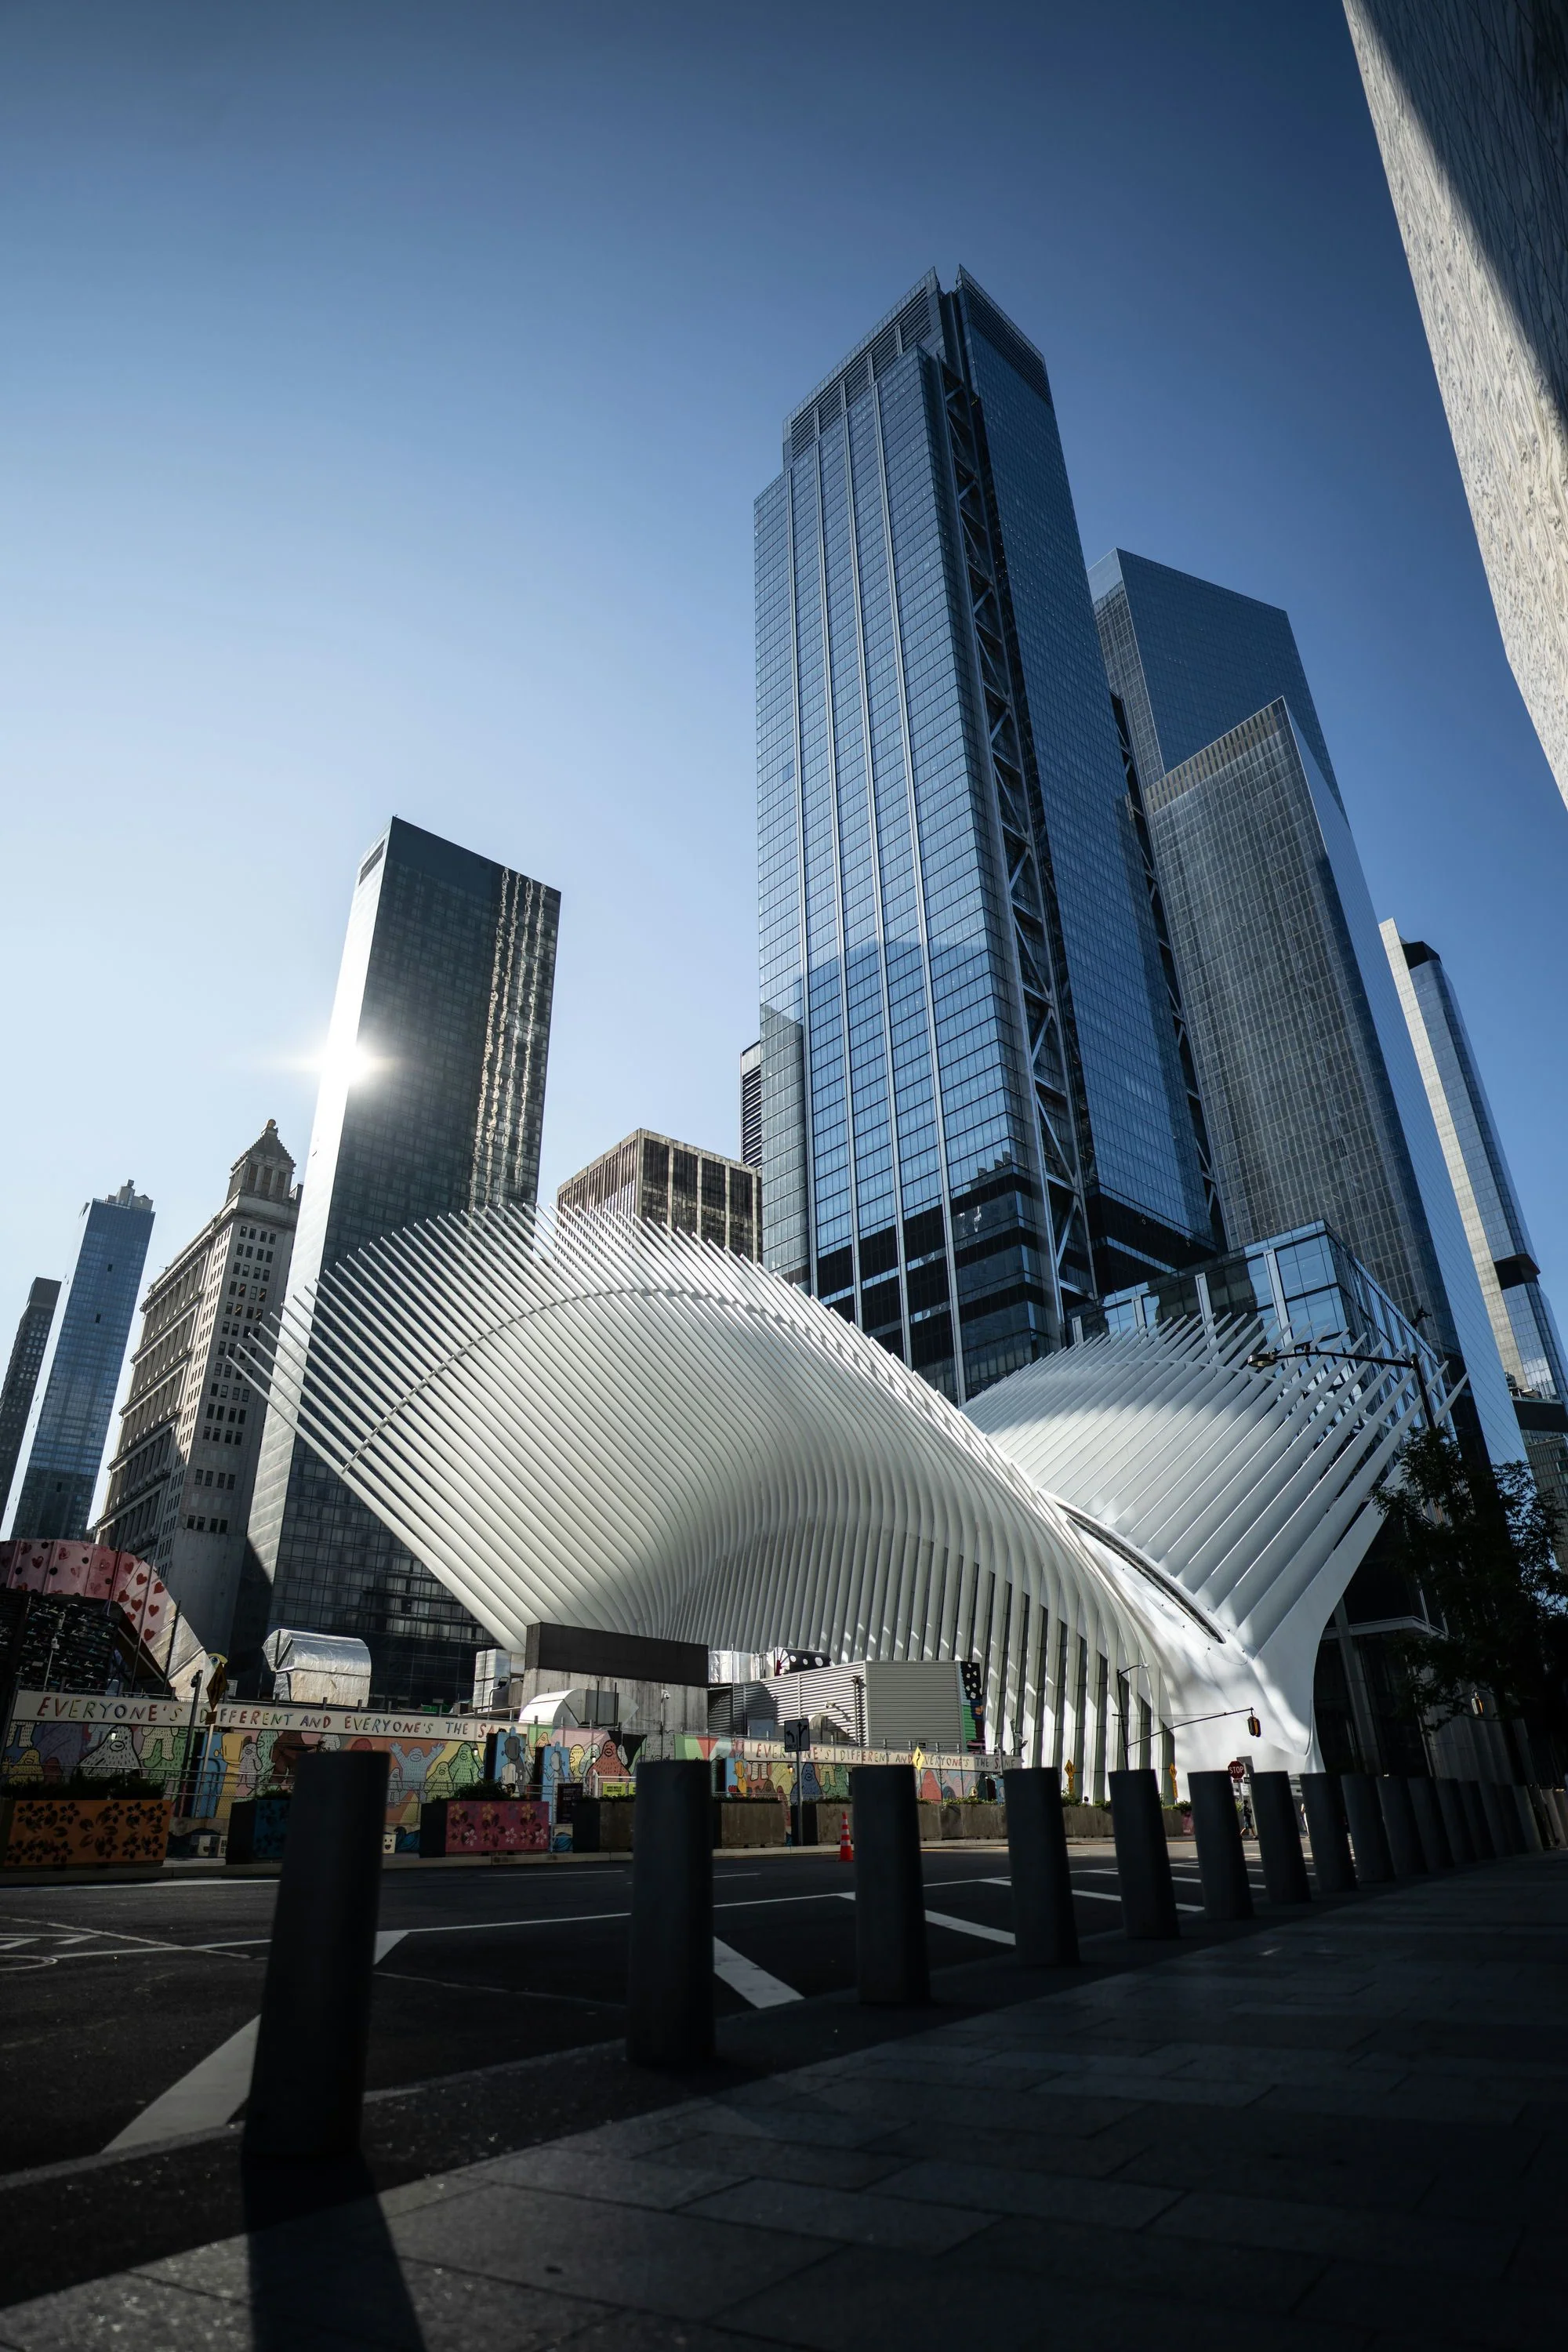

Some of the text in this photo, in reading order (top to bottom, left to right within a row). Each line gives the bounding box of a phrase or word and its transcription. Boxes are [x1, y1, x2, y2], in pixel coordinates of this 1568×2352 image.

[37, 1697, 183, 1722] EVERYONE'S
[199, 1708, 294, 1726] DFFERENT
[300, 1714, 332, 1729] AND
[344, 1715, 434, 1734] EVERYONE'S
[445, 1722, 469, 1735] THE
[756, 1743, 831, 1760] EVERNE'S
[924, 1755, 969, 1768] VERYONE'S
[975, 1757, 989, 1767] THE
[994, 1757, 1015, 1769] SME
